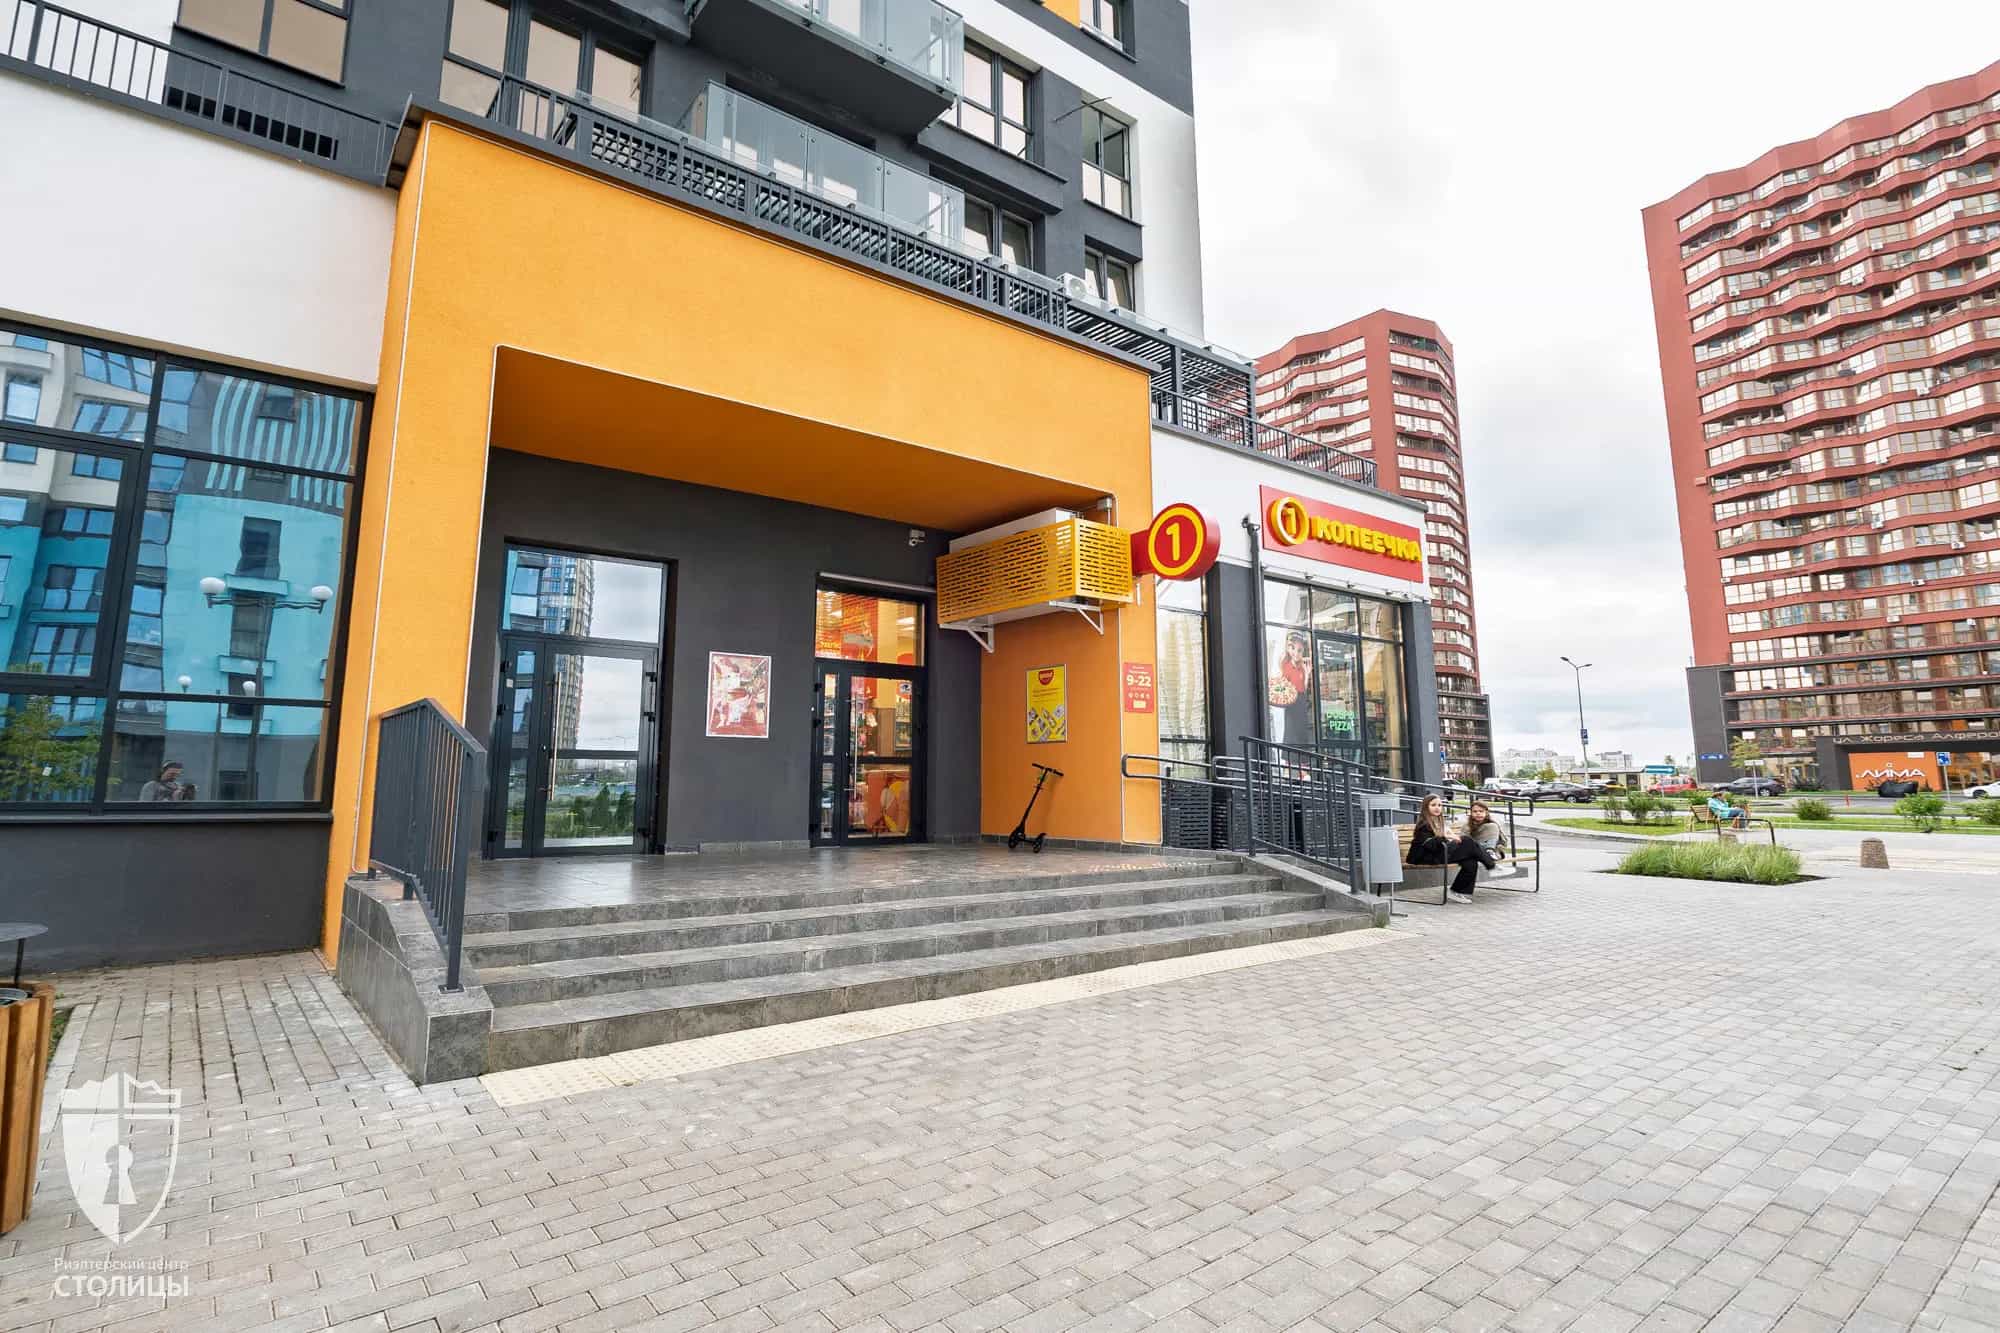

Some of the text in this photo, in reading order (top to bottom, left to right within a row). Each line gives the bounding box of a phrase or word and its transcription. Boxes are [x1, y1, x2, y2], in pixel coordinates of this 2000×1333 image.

[1166, 522, 1180, 561] 1
[1310, 515, 1423, 562] КОПЕЕЧКА
[1931, 731, 2000, 742] Алферо
